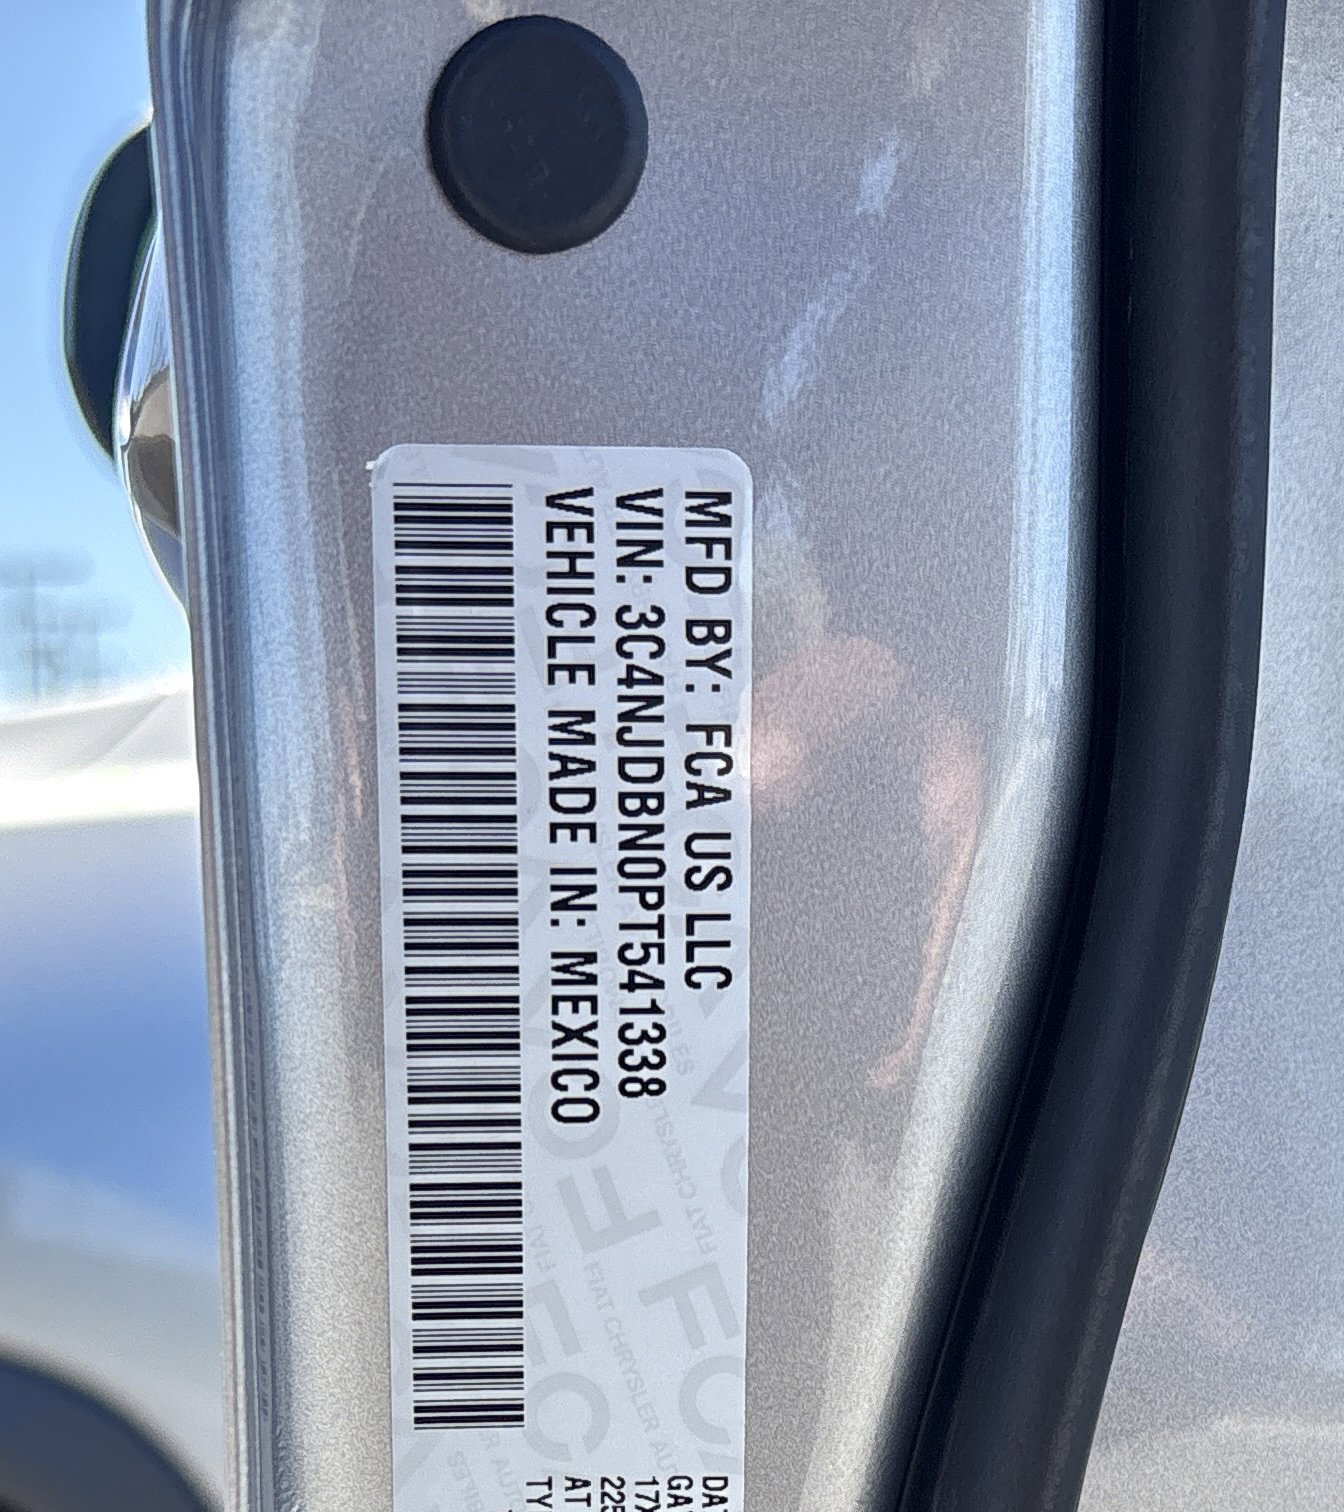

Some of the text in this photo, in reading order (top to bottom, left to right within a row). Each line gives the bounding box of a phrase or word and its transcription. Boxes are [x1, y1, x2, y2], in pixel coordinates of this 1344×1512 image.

[544, 486, 601, 1125] VEHICLE MADE IN: MEXICO
[614, 487, 668, 1099] VIN: 3C4NJDBN0PT541338
[683, 490, 734, 991] MFD BY: FCA US LLC
[644, 1097, 697, 1201] CHRYSLE
[563, 1475, 592, 1509] AT
